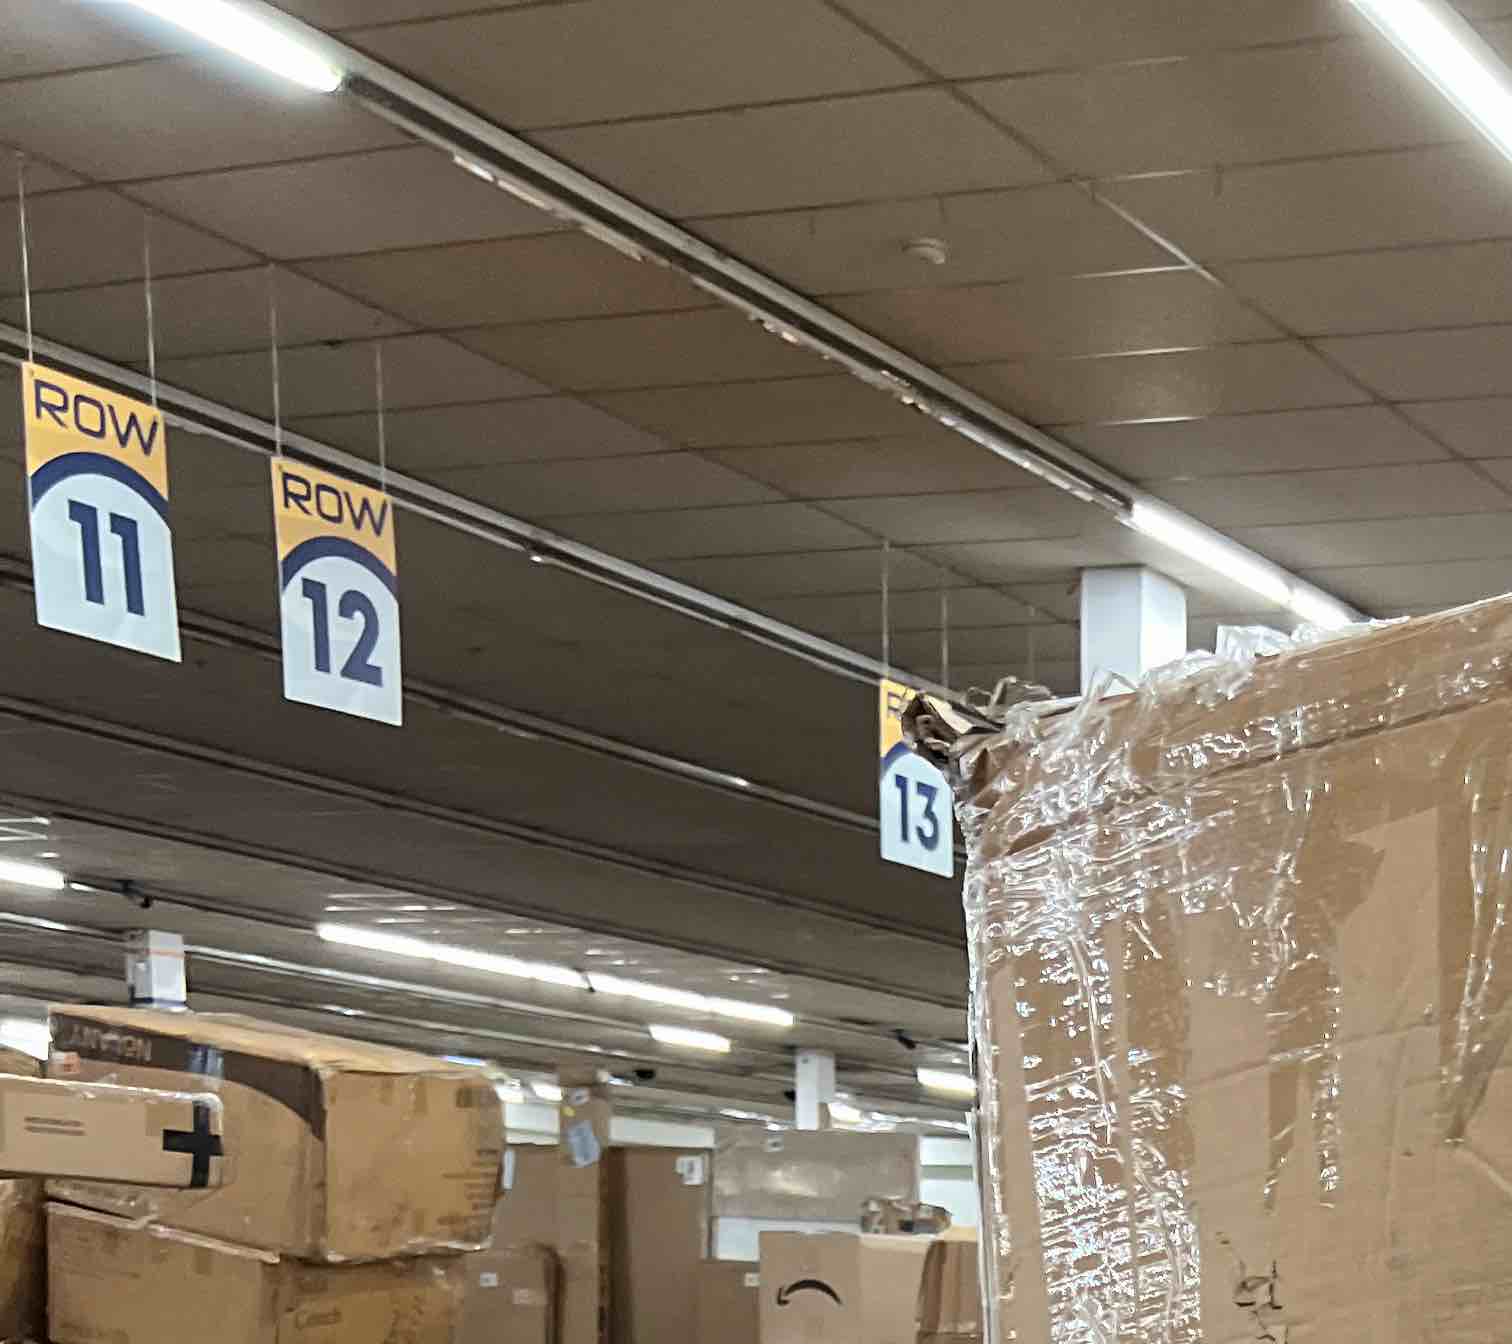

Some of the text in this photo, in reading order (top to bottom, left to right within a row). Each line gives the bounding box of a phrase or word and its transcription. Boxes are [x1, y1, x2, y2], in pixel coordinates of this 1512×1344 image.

[35, 378, 160, 457] ROW
[282, 472, 388, 537] ROW
[68, 500, 146, 616] 11
[301, 578, 383, 688] 12
[895, 774, 940, 851] 13
